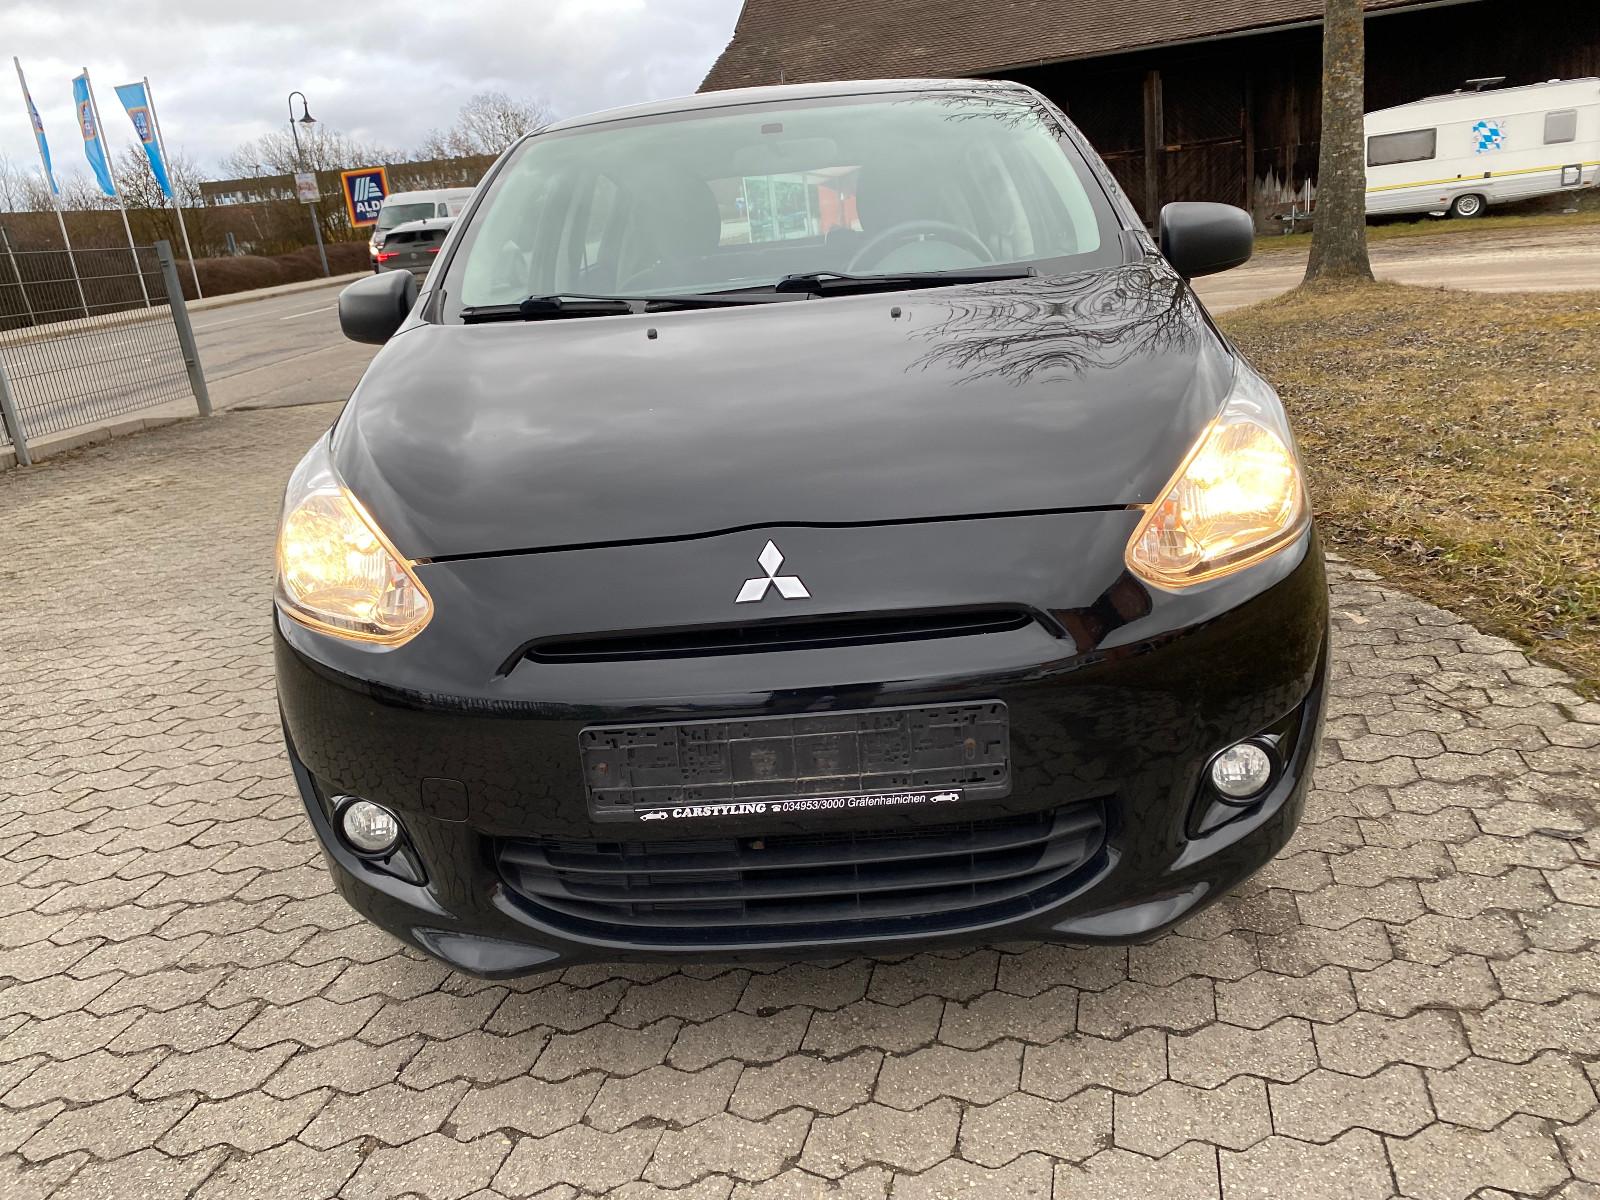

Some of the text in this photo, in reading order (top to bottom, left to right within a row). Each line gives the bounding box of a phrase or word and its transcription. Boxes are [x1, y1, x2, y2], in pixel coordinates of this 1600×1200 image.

[673, 794, 926, 818] CARSTYLING 034953/3000 Gräfenhainichen
